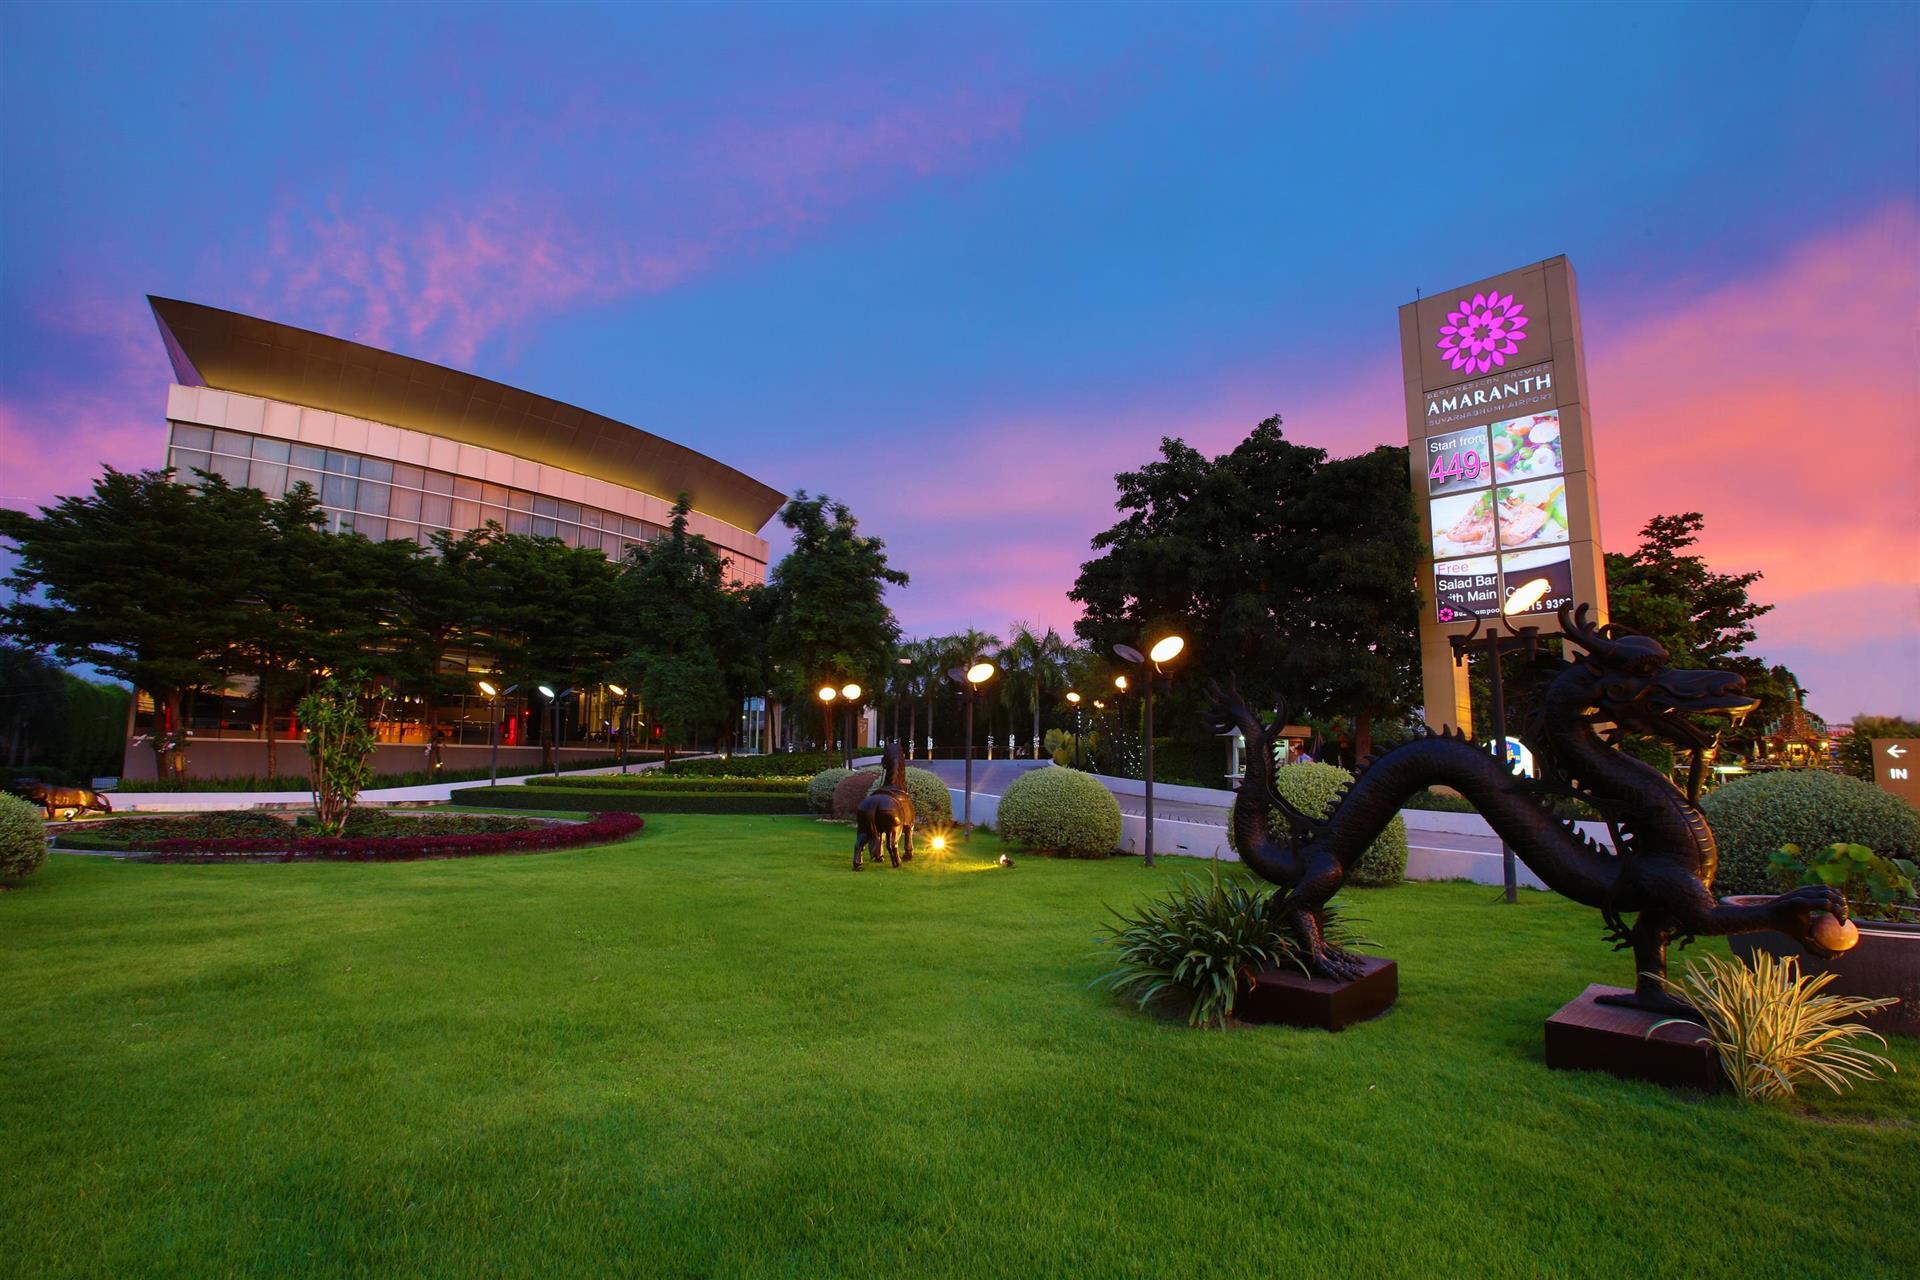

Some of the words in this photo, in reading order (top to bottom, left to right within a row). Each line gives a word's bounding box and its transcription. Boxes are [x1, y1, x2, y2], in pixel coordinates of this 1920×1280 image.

[1427, 373, 1551, 417] AMARANTH
[1507, 392, 1553, 409] AIRPORT
[1430, 439, 1457, 453] Start
[1459, 433, 1487, 446] from
[1437, 561, 1469, 575] Free
[1438, 577, 1472, 591] Salad
[1476, 574, 1497, 586] Bar
[1467, 589, 1497, 602] Main
[1889, 768, 1908, 780] IN
